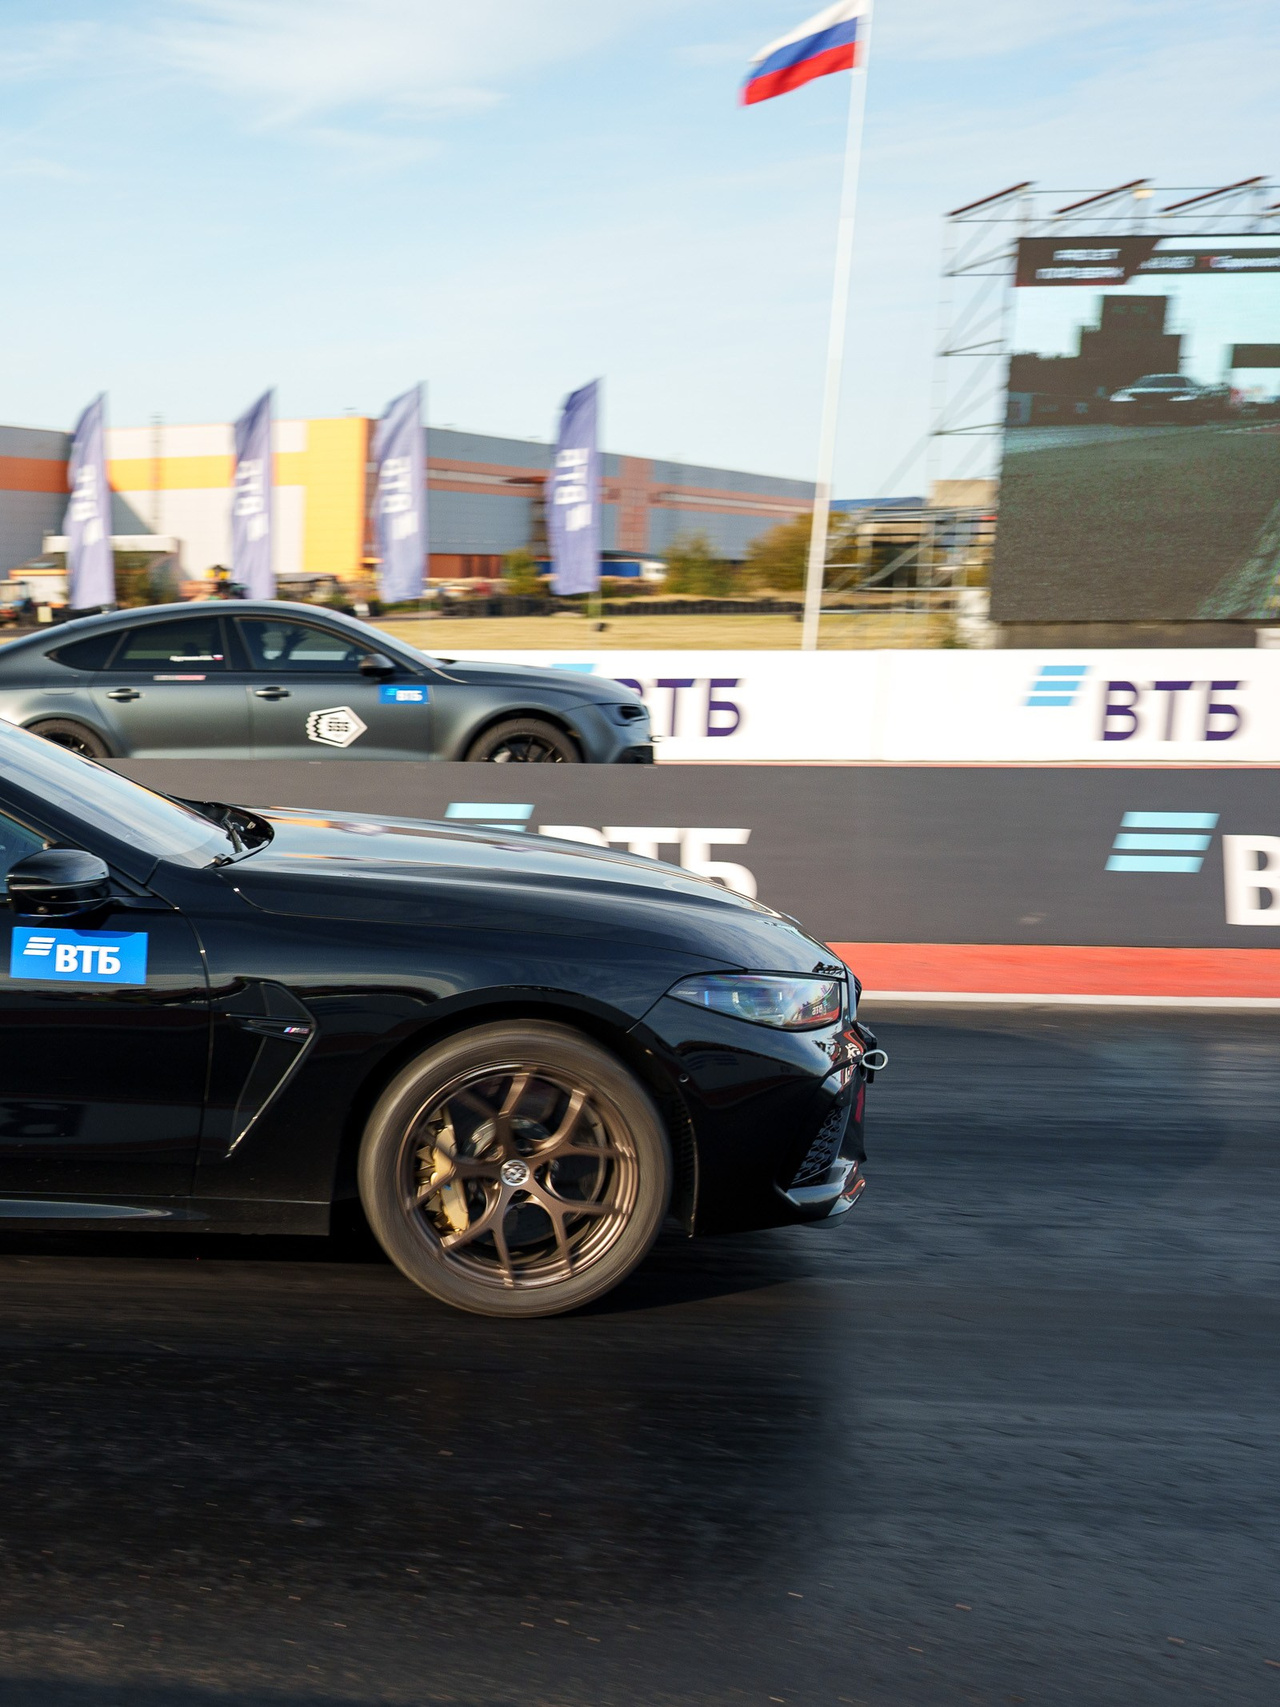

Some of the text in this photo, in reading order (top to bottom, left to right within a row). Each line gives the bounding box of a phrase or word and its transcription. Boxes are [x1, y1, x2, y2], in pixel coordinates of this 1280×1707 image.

[610, 678, 743, 737] ТБ
[1100, 680, 1248, 741] ВТБ
[55, 944, 121, 975] ВТБ
